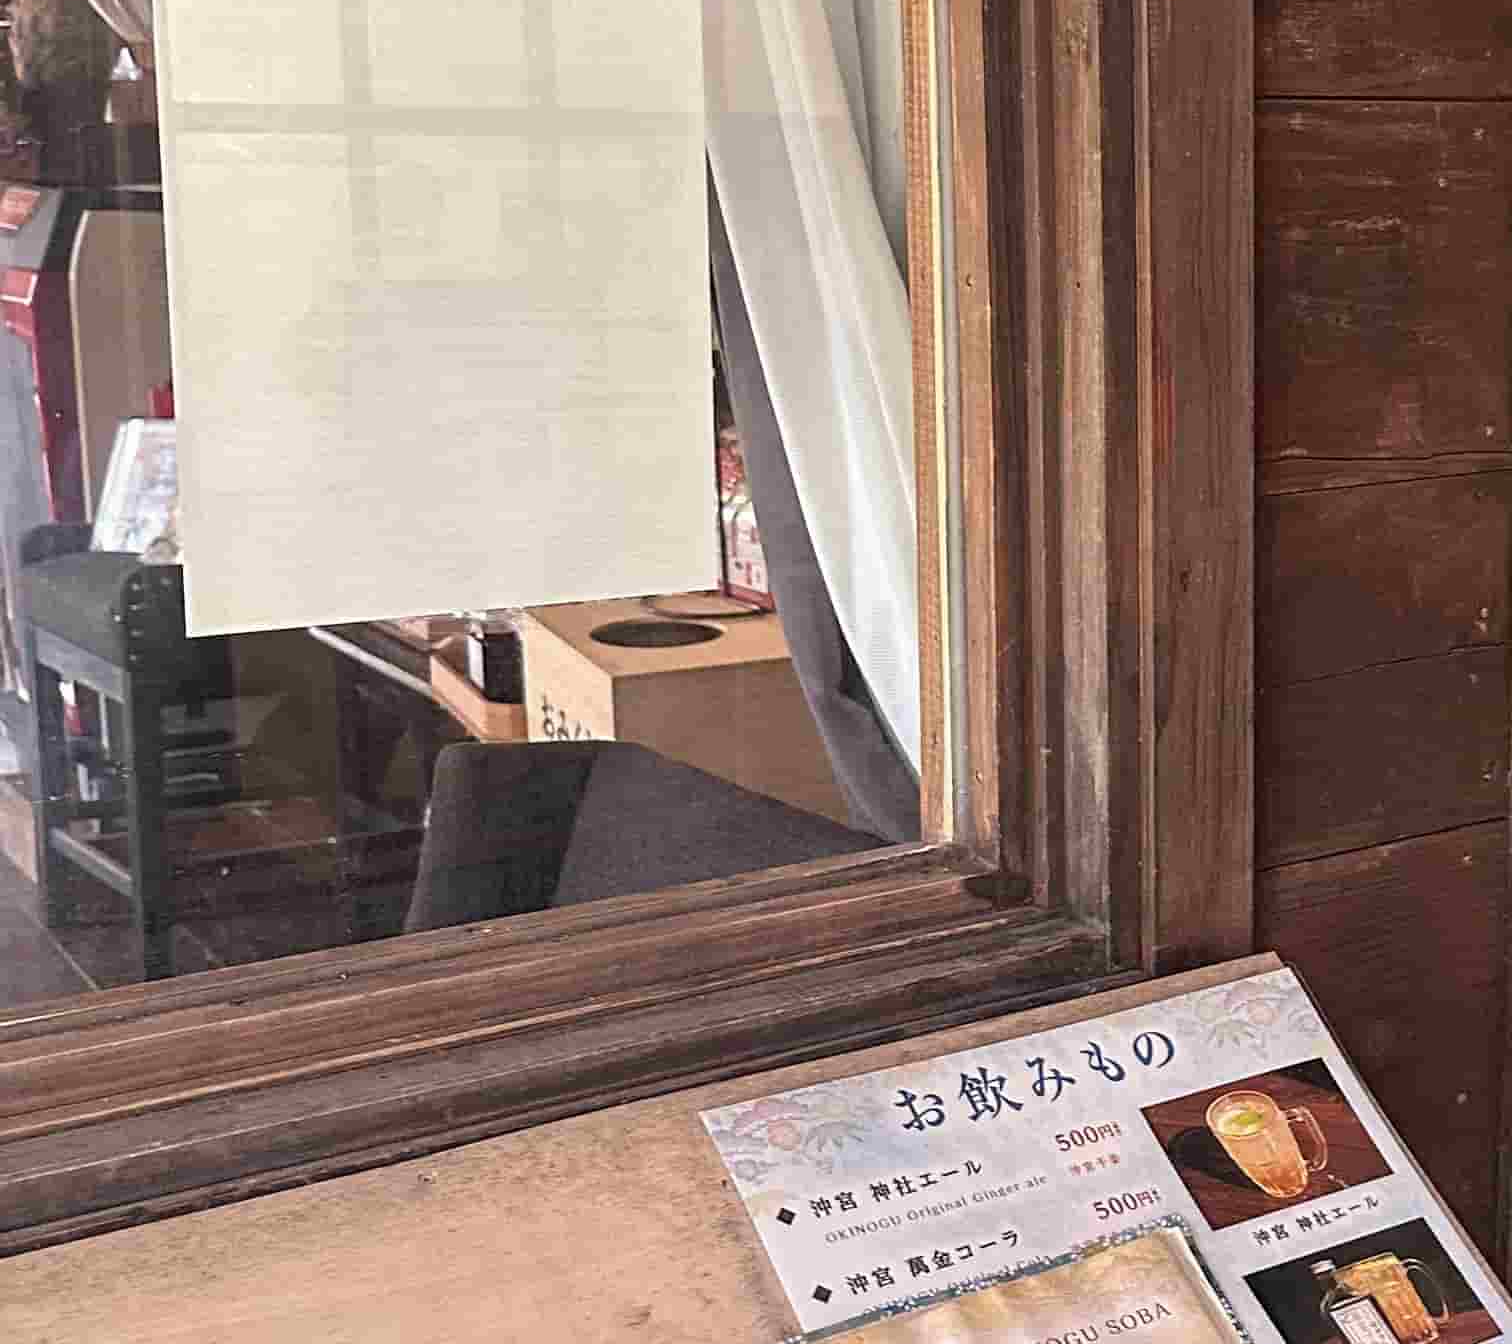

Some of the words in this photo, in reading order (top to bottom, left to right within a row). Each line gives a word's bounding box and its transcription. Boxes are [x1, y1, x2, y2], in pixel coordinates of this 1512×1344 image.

[895, 1031, 1175, 1131] お飲みもの
[1055, 1123, 1114, 1152] 500円
[809, 1189, 858, 1219] 沖宮
[869, 1159, 983, 1204] 神社エール
[1093, 1191, 1154, 1220] 500円
[824, 1215, 902, 1244] OKINOGU
[906, 1195, 968, 1224] Original
[971, 1180, 1020, 1206] Ginger
[1023, 1173, 1049, 1189] ale
[845, 1264, 896, 1296] 沖宮
[1105, 1302, 1172, 1337] SOBA
